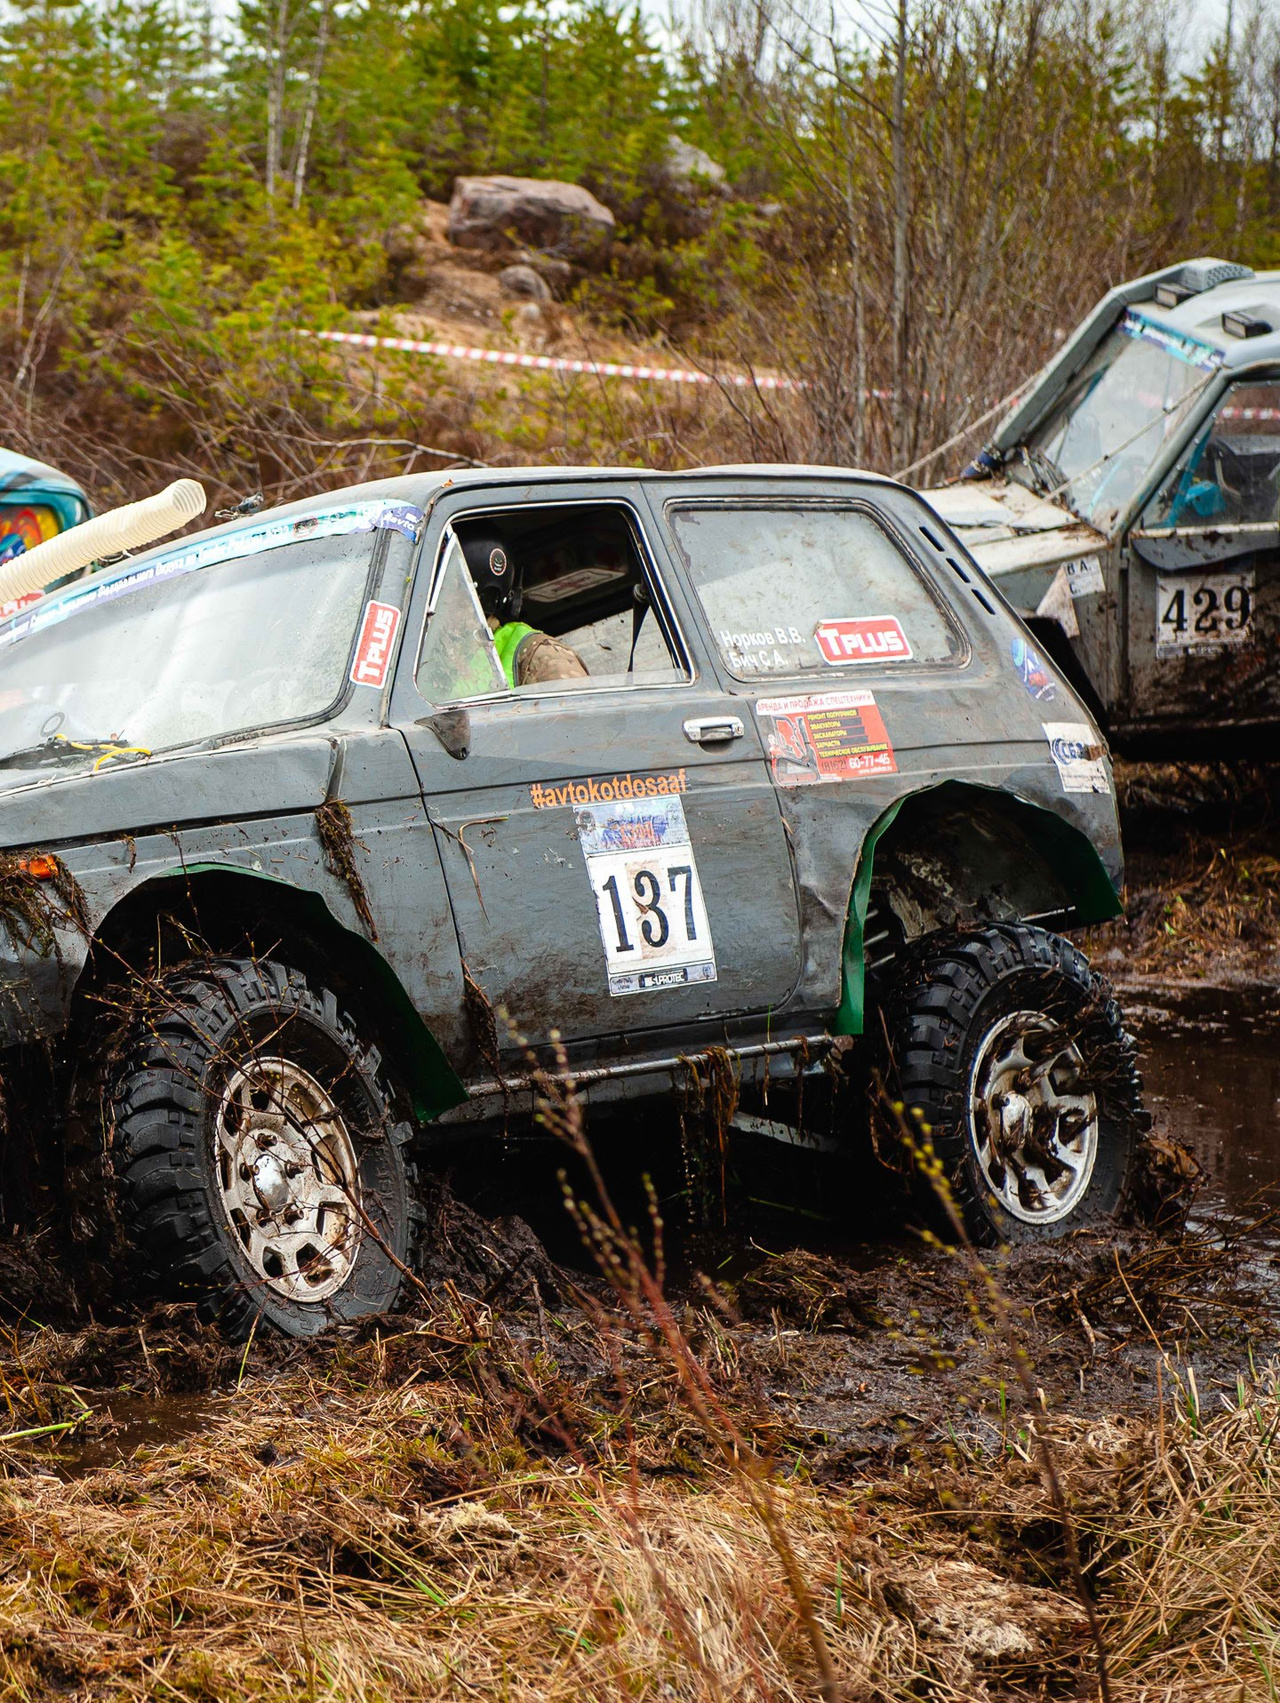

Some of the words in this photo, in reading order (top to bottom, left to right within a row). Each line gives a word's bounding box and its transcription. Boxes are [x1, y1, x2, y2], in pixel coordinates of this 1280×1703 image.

[1161, 586, 1250, 633] 429
[357, 609, 394, 679] TPLUS
[720, 629, 775, 650] Норков
[820, 628, 904, 656] TPLUS
[728, 651, 757, 669] Бич
[757, 701, 784, 713] АРЕНДА
[789, 698, 825, 711] ПРОДАЖА
[825, 694, 872, 706] СПЕЦТЕХНИКИ
[821, 759, 847, 772] (8162)
[849, 753, 891, 769] 60-77-45
[530, 768, 687, 808] #avtokotdosaaf
[602, 865, 697, 953] 137
